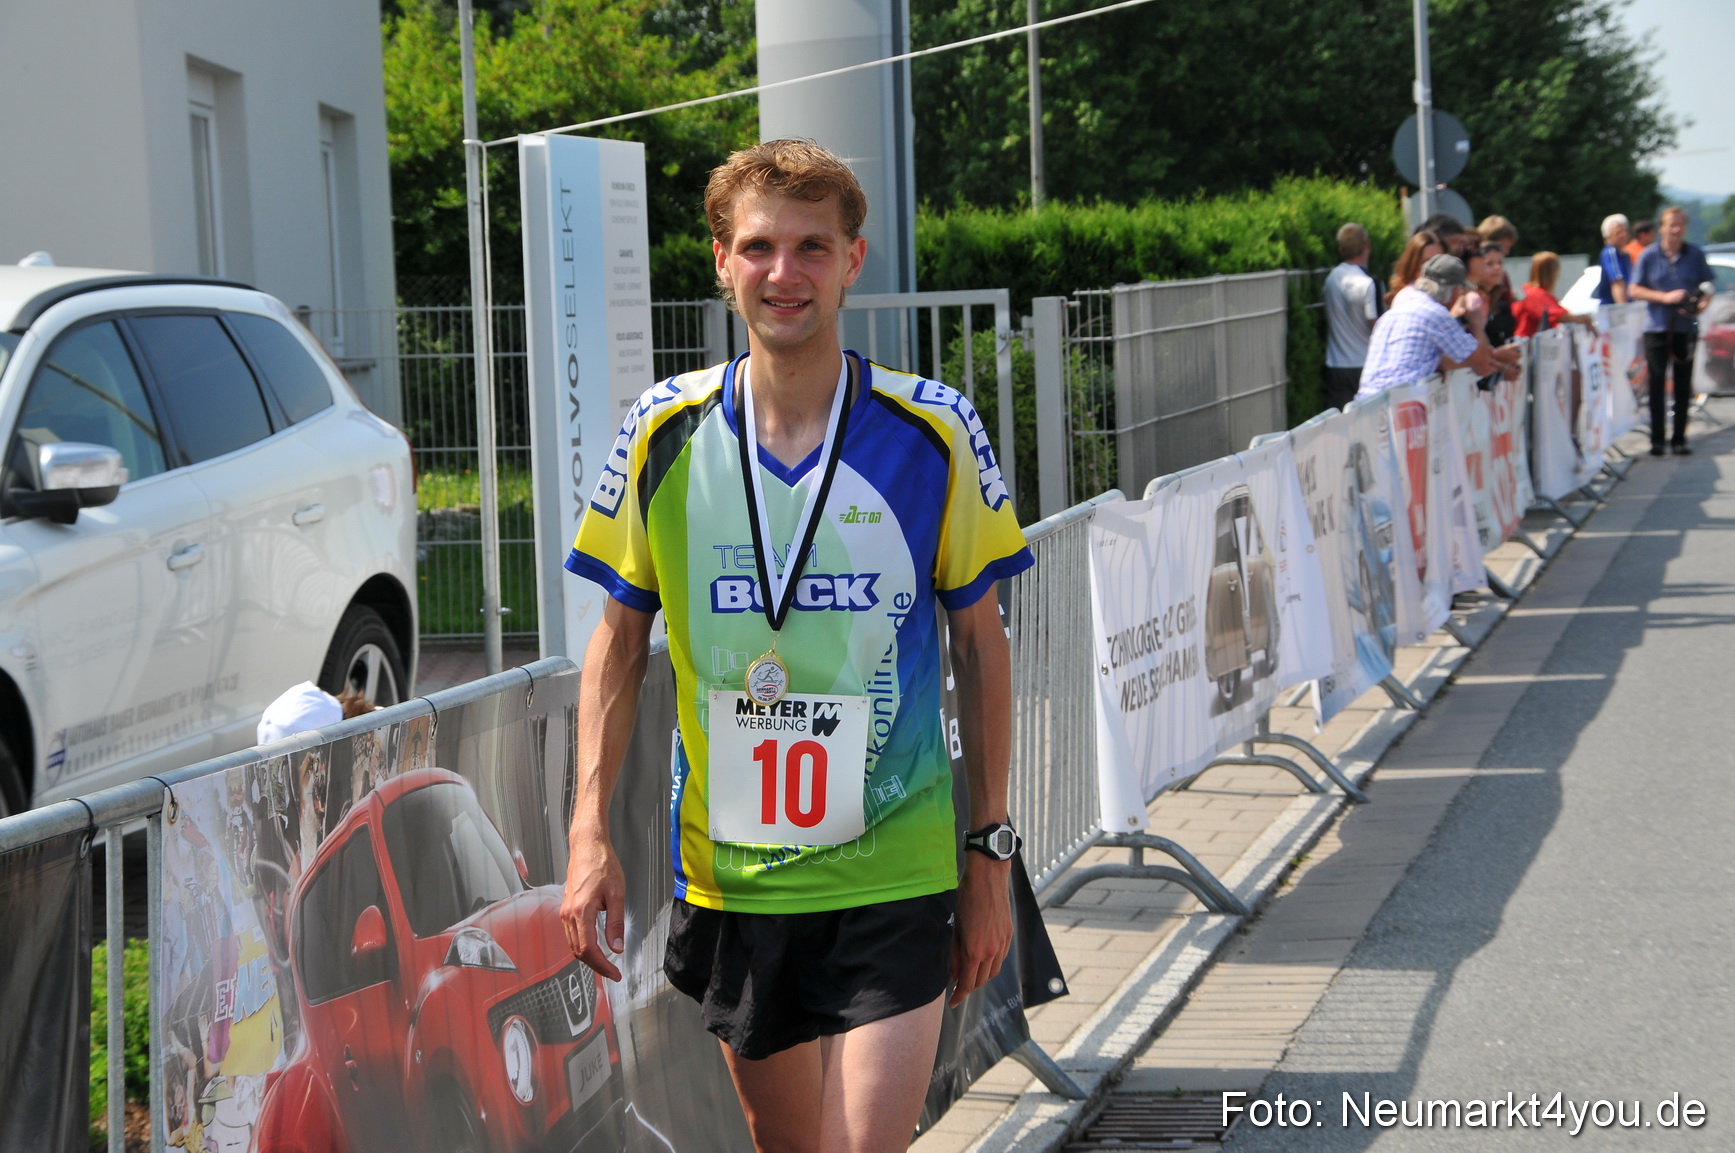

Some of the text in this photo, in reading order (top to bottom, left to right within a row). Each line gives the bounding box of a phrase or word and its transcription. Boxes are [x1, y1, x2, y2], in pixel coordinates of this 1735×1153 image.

[710, 572, 881, 614] BCK
[735, 716, 808, 732] WERBUNG
[752, 738, 829, 829] 10
[579, 1051, 603, 1093] JUKE
